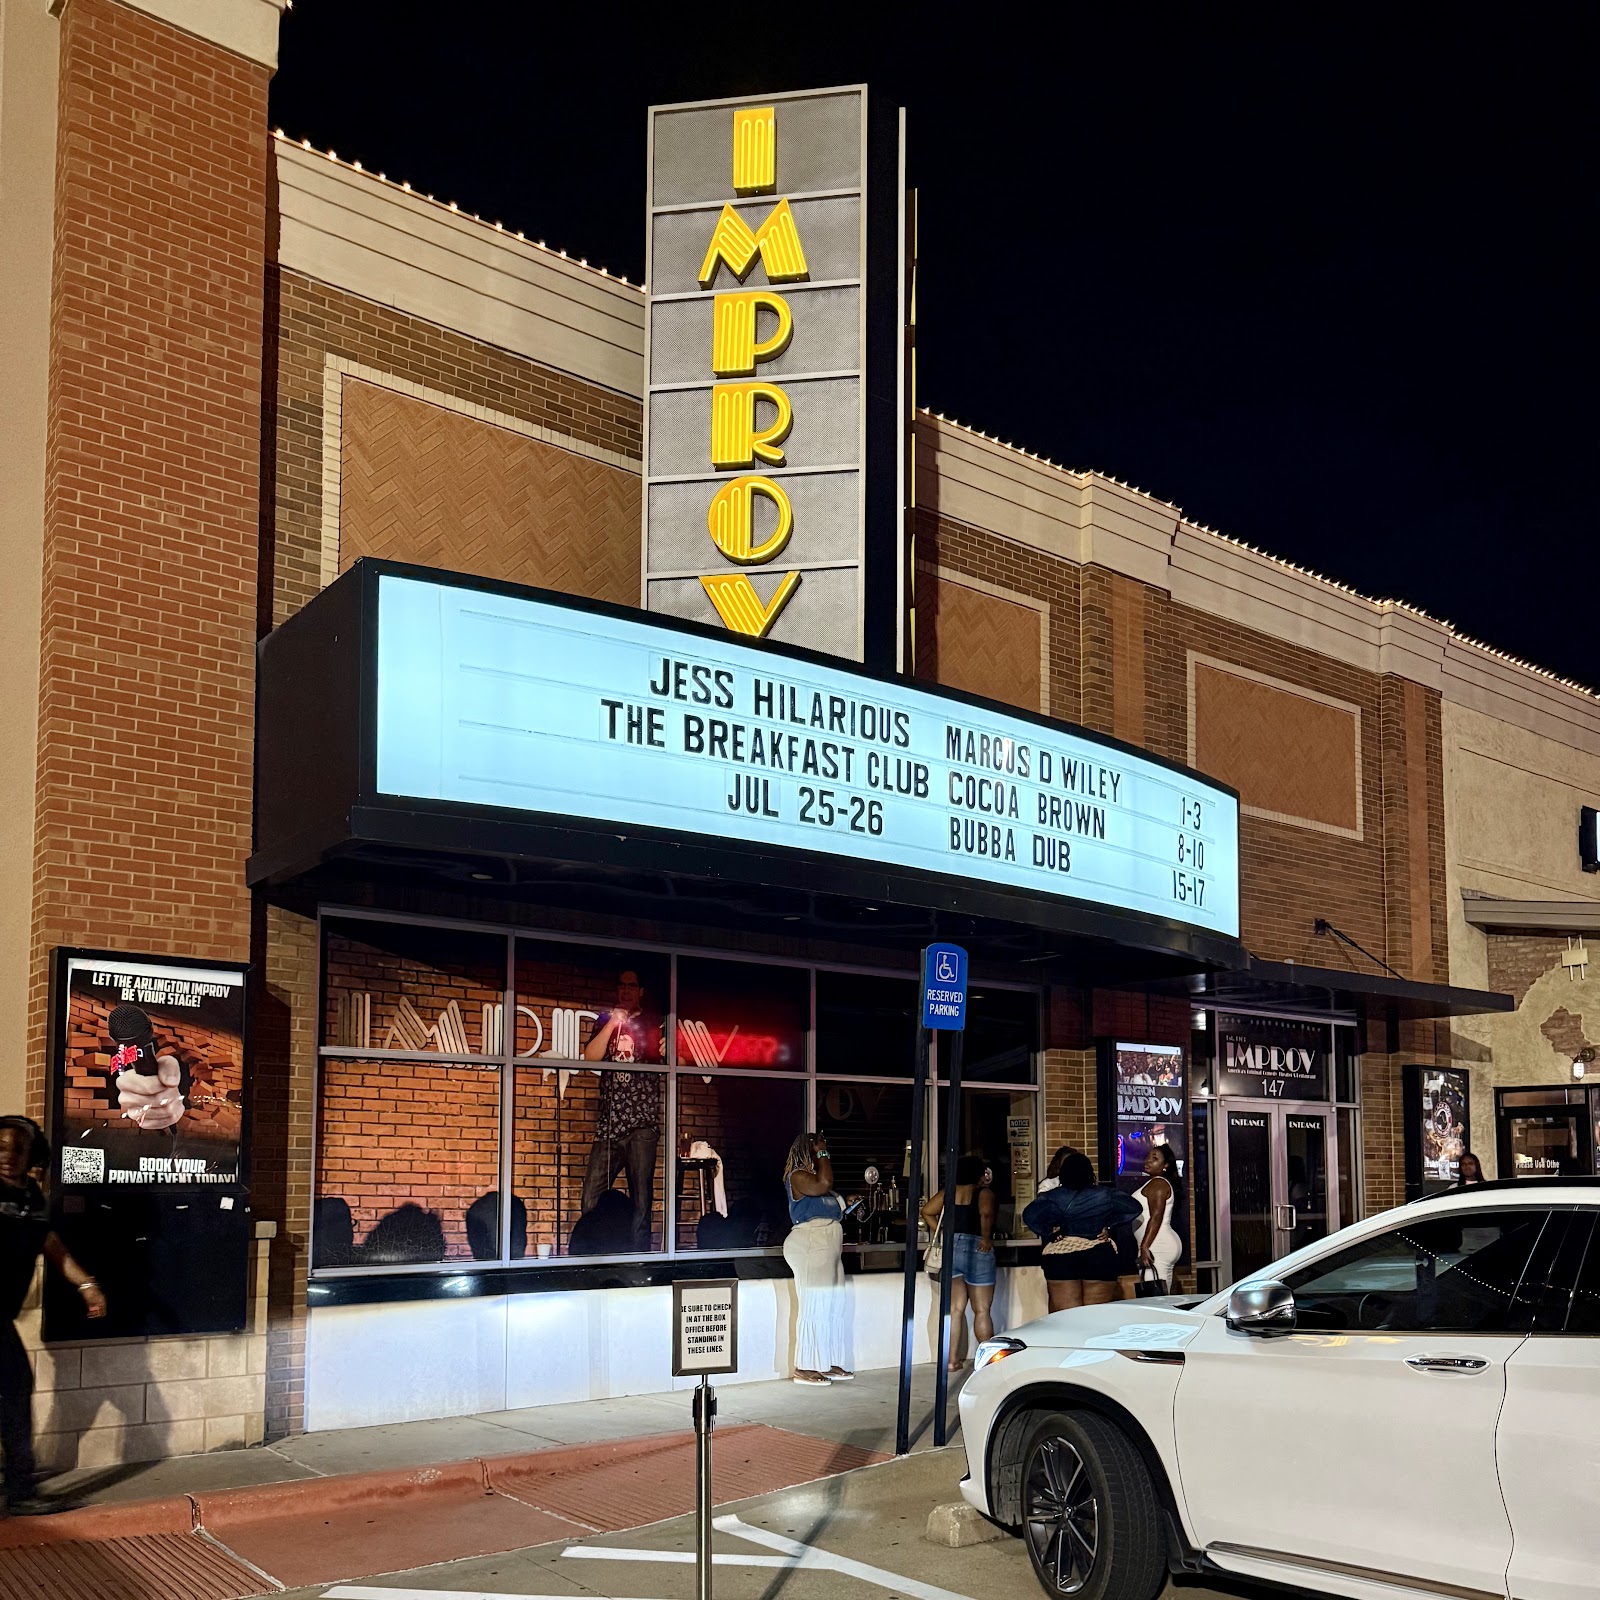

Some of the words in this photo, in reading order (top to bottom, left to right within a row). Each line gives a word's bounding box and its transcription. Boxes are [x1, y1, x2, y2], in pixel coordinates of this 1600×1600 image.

[698, 106, 809, 638] IMPROV
[649, 657, 735, 709] JESS
[754, 677, 910, 748] HILARIOUS
[600, 698, 666, 748] THE
[683, 713, 855, 782] BREAKFAST
[866, 751, 930, 799] CLUB
[945, 725, 1031, 778] MARCUS
[1039, 750, 1052, 784] D
[1061, 755, 1122, 803] WILEY
[1181, 796, 1202, 831] 1-3
[727, 773, 780, 818] JUL
[798, 786, 884, 836] 25-26
[948, 770, 1020, 819] COCOA
[1037, 792, 1106, 840] BROWN
[1177, 833, 1205, 871] 8-10
[949, 816, 1017, 862] BUBBA
[1032, 833, 1072, 873] DUB
[1172, 869, 1206, 907] 15-17
[92, 972, 111, 987] LET
[113, 974, 133, 989] THE
[133, 976, 191, 995] ARLINGTON
[191, 982, 230, 999] IMPROV
[121, 987, 135, 1002] BE
[137, 989, 166, 1004] YOUR
[167, 993, 202, 1008] STAGE!
[926, 988, 964, 1003] RESERVED
[929, 1003, 960, 1017] PARKING
[337, 991, 740, 1085] IMPRV
[1226, 1041, 1316, 1075] IMPROV
[1261, 1078, 1285, 1097] 147
[1116, 1093, 1182, 1116] IMPROV
[1010, 1119, 1029, 1127] NOTICE
[1231, 1118, 1265, 1127] ENTRANCE
[1288, 1120, 1321, 1130] ENTRANCE
[139, 1157, 172, 1172] BOOK
[173, 1158, 207, 1173] YOUR
[1515, 1159, 1534, 1169] Please
[1534, 1159, 1546, 1169] Use
[1546, 1158, 1560, 1169] Othe
[108, 1169, 155, 1184] PRIVATE
[157, 1171, 193, 1184] EVENT
[687, 1304, 704, 1313] SURE
[704, 1304, 712, 1312] TO
[686, 1315, 693, 1323] IN
[693, 1315, 701, 1323] AT
[702, 1314, 713, 1322] THE
[714, 1313, 726, 1322] BOX
[685, 1325, 705, 1334] OFFICE
[705, 1324, 727, 1333] BEFORE
[687, 1335, 717, 1344] STANDING
[717, 1334, 725, 1342] IN
[687, 1346, 706, 1354] THESE
[706, 1345, 724, 1354] LINES.
